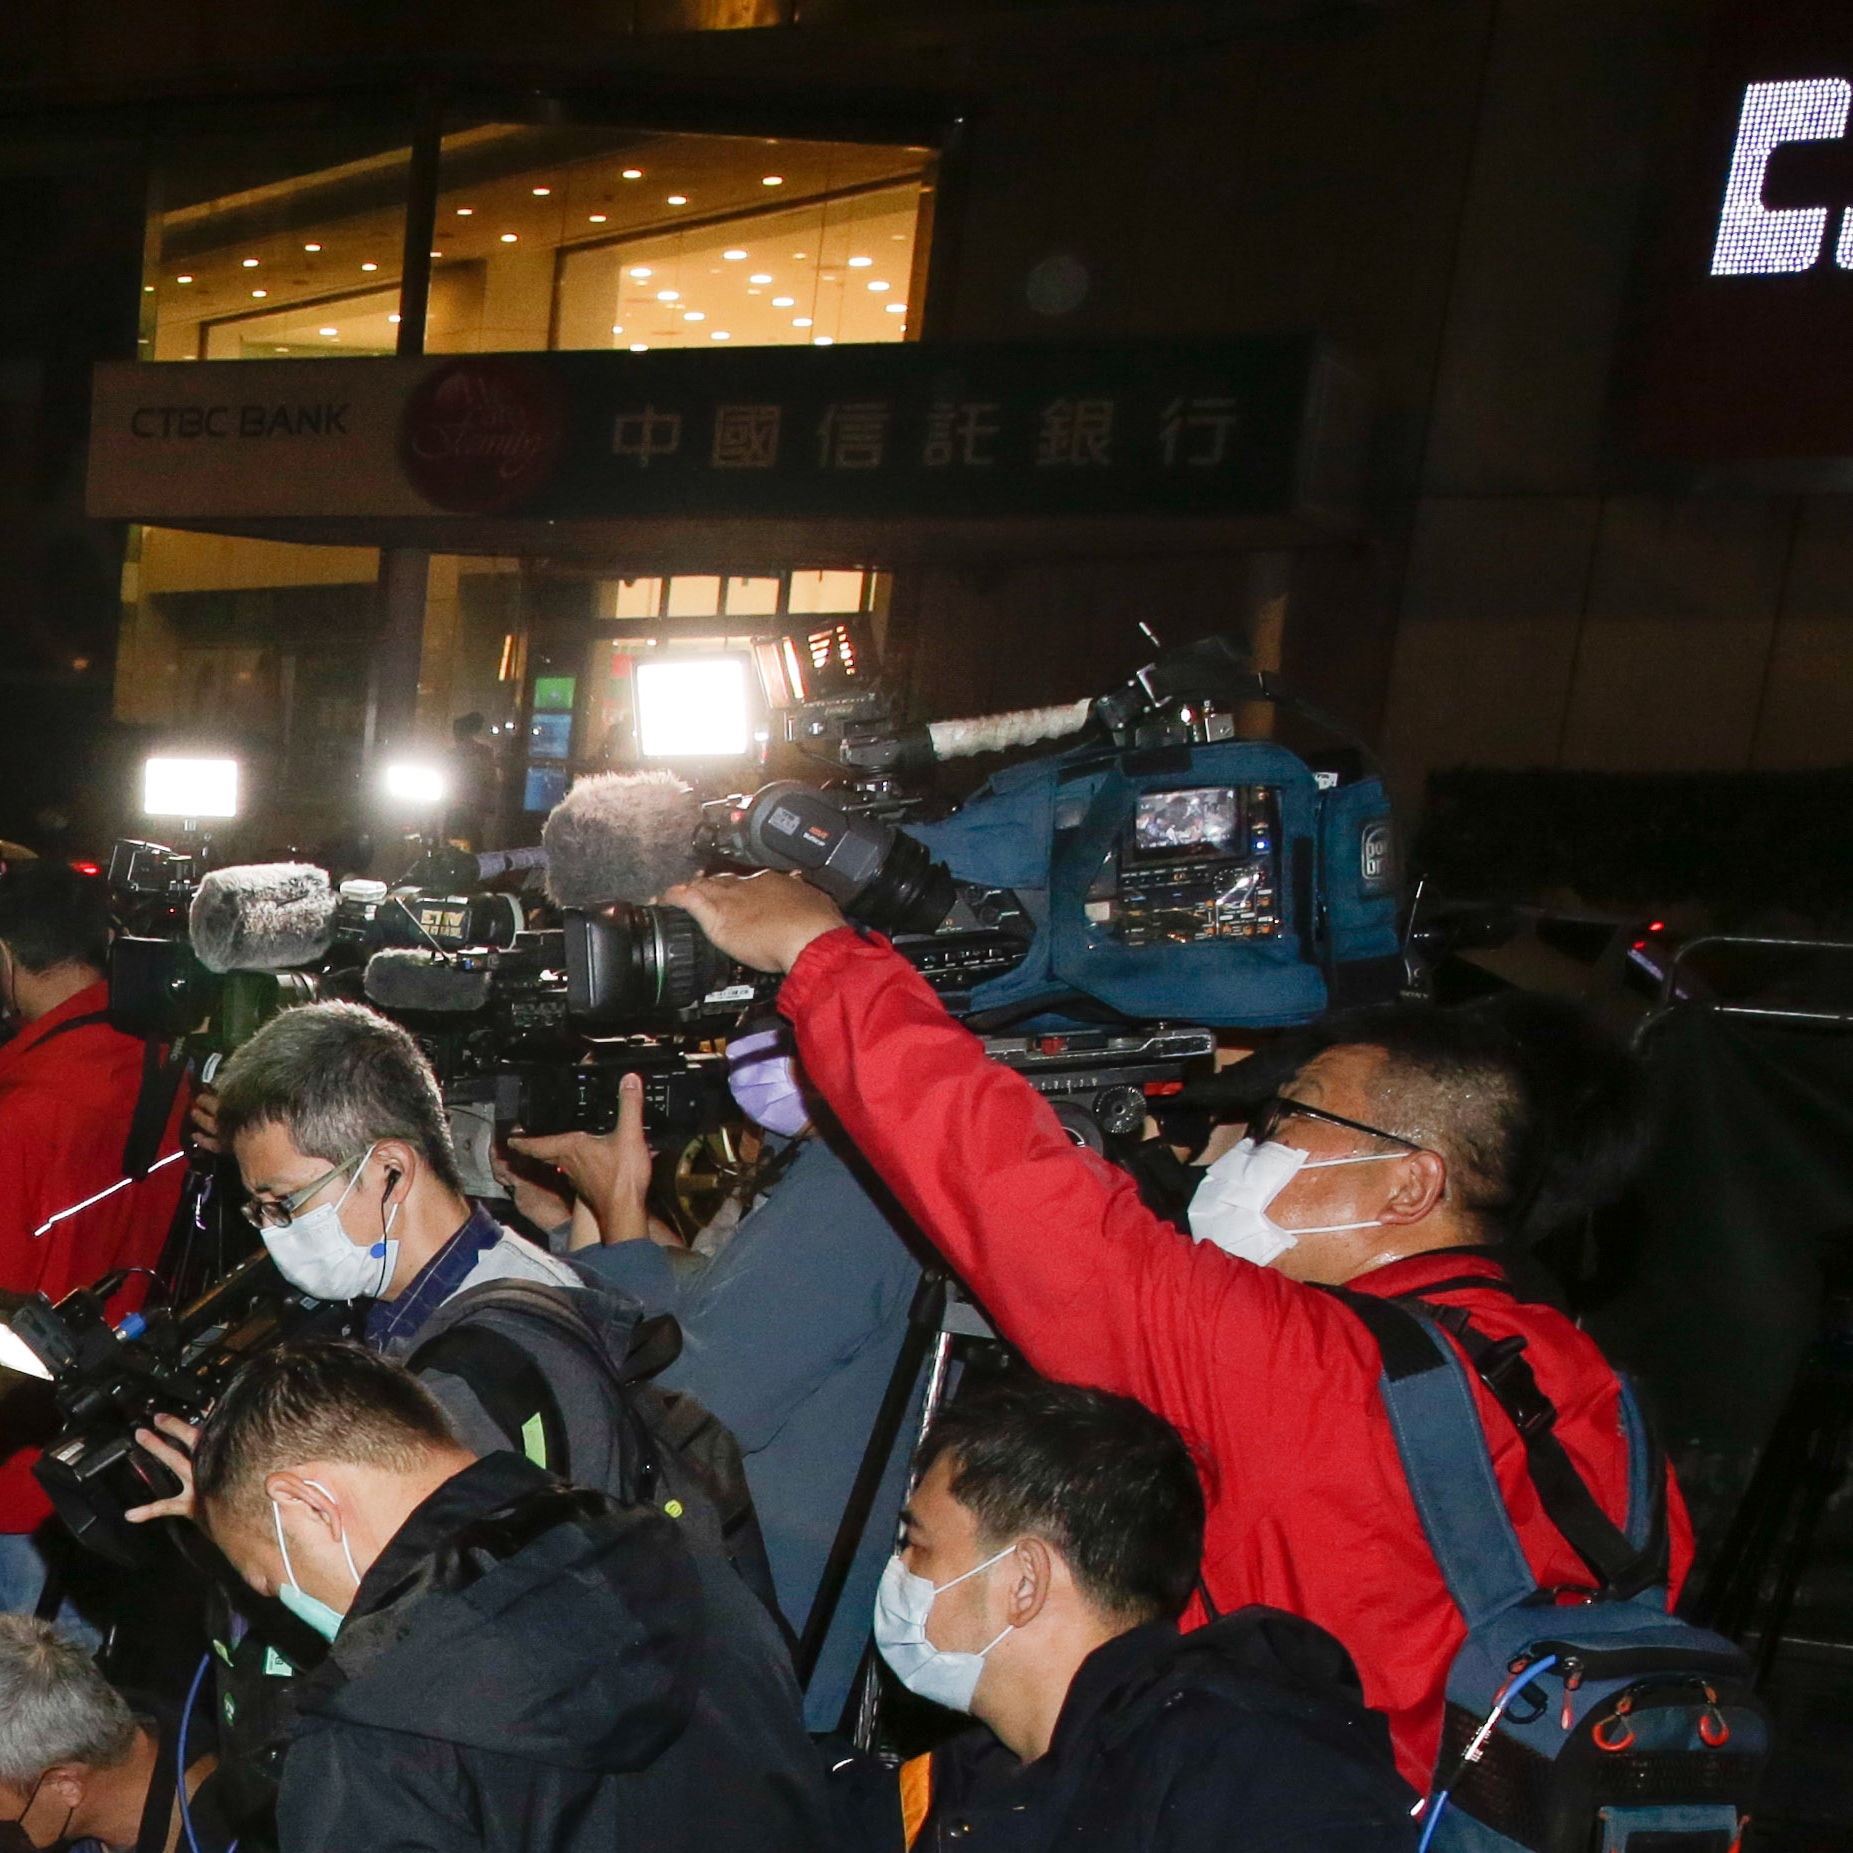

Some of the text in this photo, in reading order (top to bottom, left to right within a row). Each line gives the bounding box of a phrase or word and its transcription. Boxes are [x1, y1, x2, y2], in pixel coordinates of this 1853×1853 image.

[130, 402, 351, 439] CTBC BANK
[612, 398, 1237, 470] 中國信託銀行
